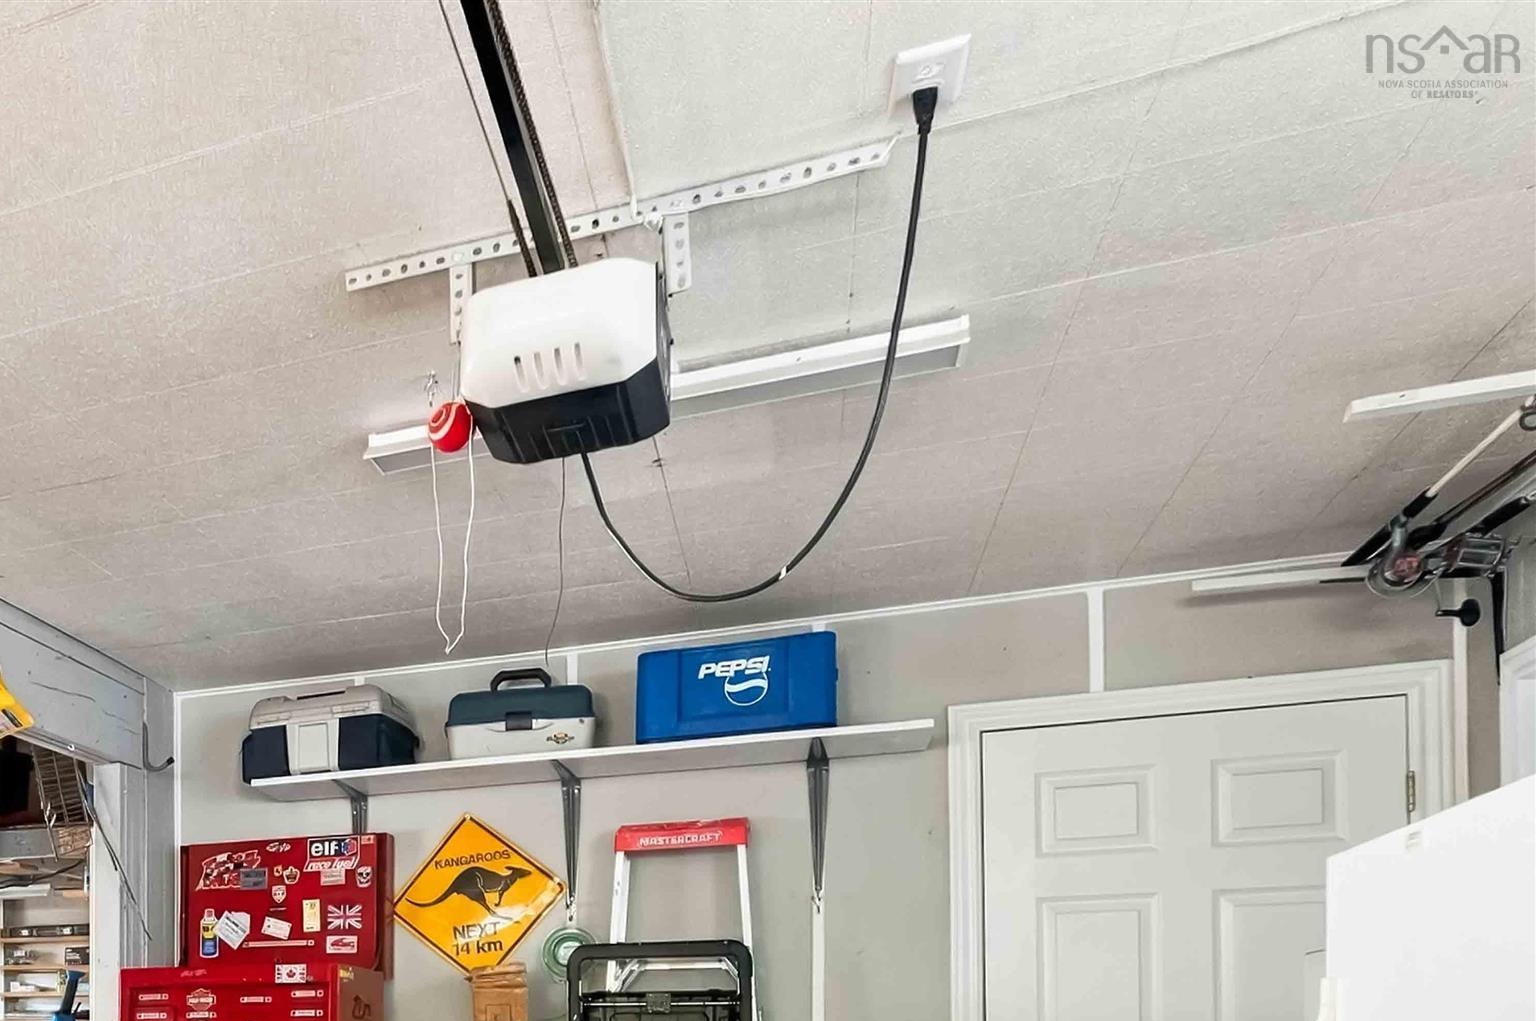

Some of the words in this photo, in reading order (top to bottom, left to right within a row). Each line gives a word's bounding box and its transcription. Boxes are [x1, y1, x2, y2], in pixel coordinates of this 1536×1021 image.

[697, 655, 770, 680] PEPSI
[310, 840, 339, 857] elf
[638, 831, 722, 847] MASTERCRAFT
[434, 849, 512, 870] KANGAROOS
[452, 921, 501, 941] NEXT
[453, 942, 470, 957] 14
[476, 939, 503, 955] km
